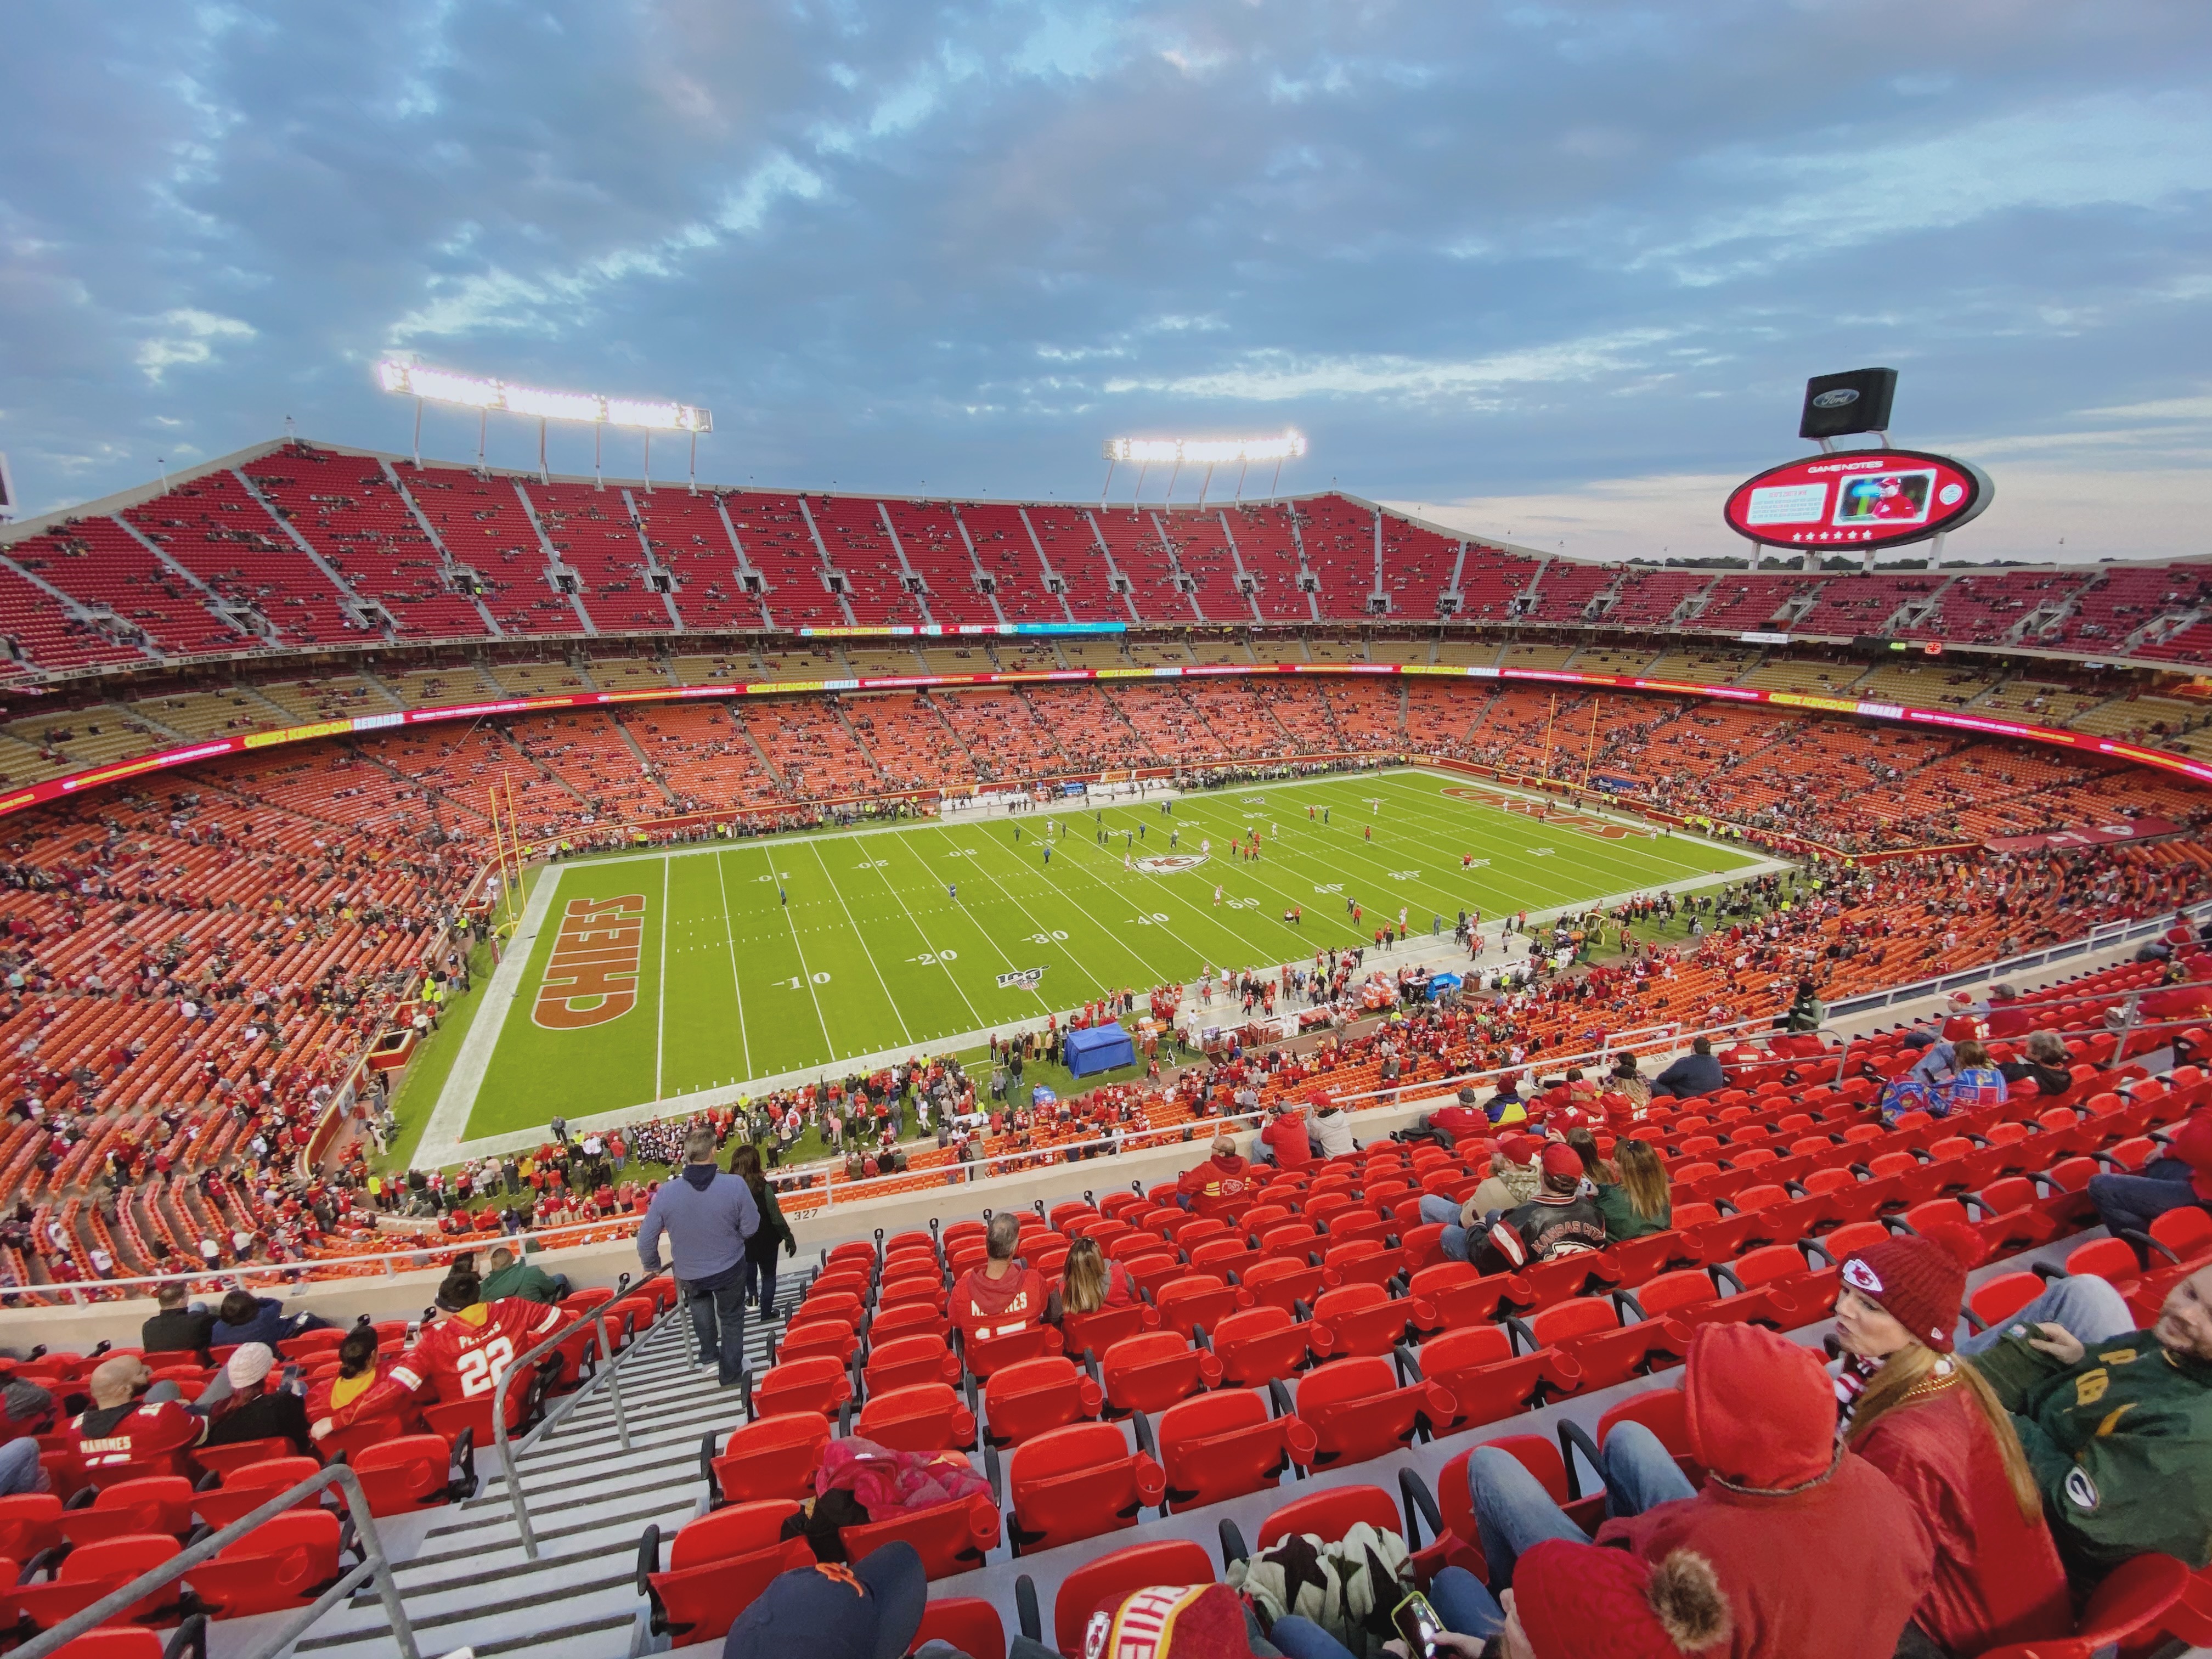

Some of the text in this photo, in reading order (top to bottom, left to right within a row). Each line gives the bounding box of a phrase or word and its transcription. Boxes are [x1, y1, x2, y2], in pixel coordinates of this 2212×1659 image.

[1821, 393, 1850, 405] Ford
[1926, 642, 1942, 654] 25
[746, 684, 777, 693] CHIEFS
[778, 681, 823, 691] KINGDOM
[1768, 693, 1904, 718] CHIEFS KINGDOM REWARDS
[245, 714, 404, 748] CHIEFS KINGDOM REWARDS
[1440, 787, 1650, 840] CHIEFS
[858, 859, 889, 870] 20
[759, 871, 792, 882] 10
[1313, 883, 1342, 895] 40
[1225, 896, 1261, 910] 50
[1136, 912, 1169, 926] 40
[1031, 929, 1069, 945] 30
[531, 894, 646, 1031] CHIEFS
[918, 949, 958, 966] 20
[787, 972, 831, 990] 10
[1650, 1053, 1668, 1063] 326
[794, 1208, 818, 1221] 327
[1531, 1221, 1606, 1255] KANSAS CITY
[456, 1335, 514, 1398] 22
[80, 1435, 132, 1453] MAHOMES
